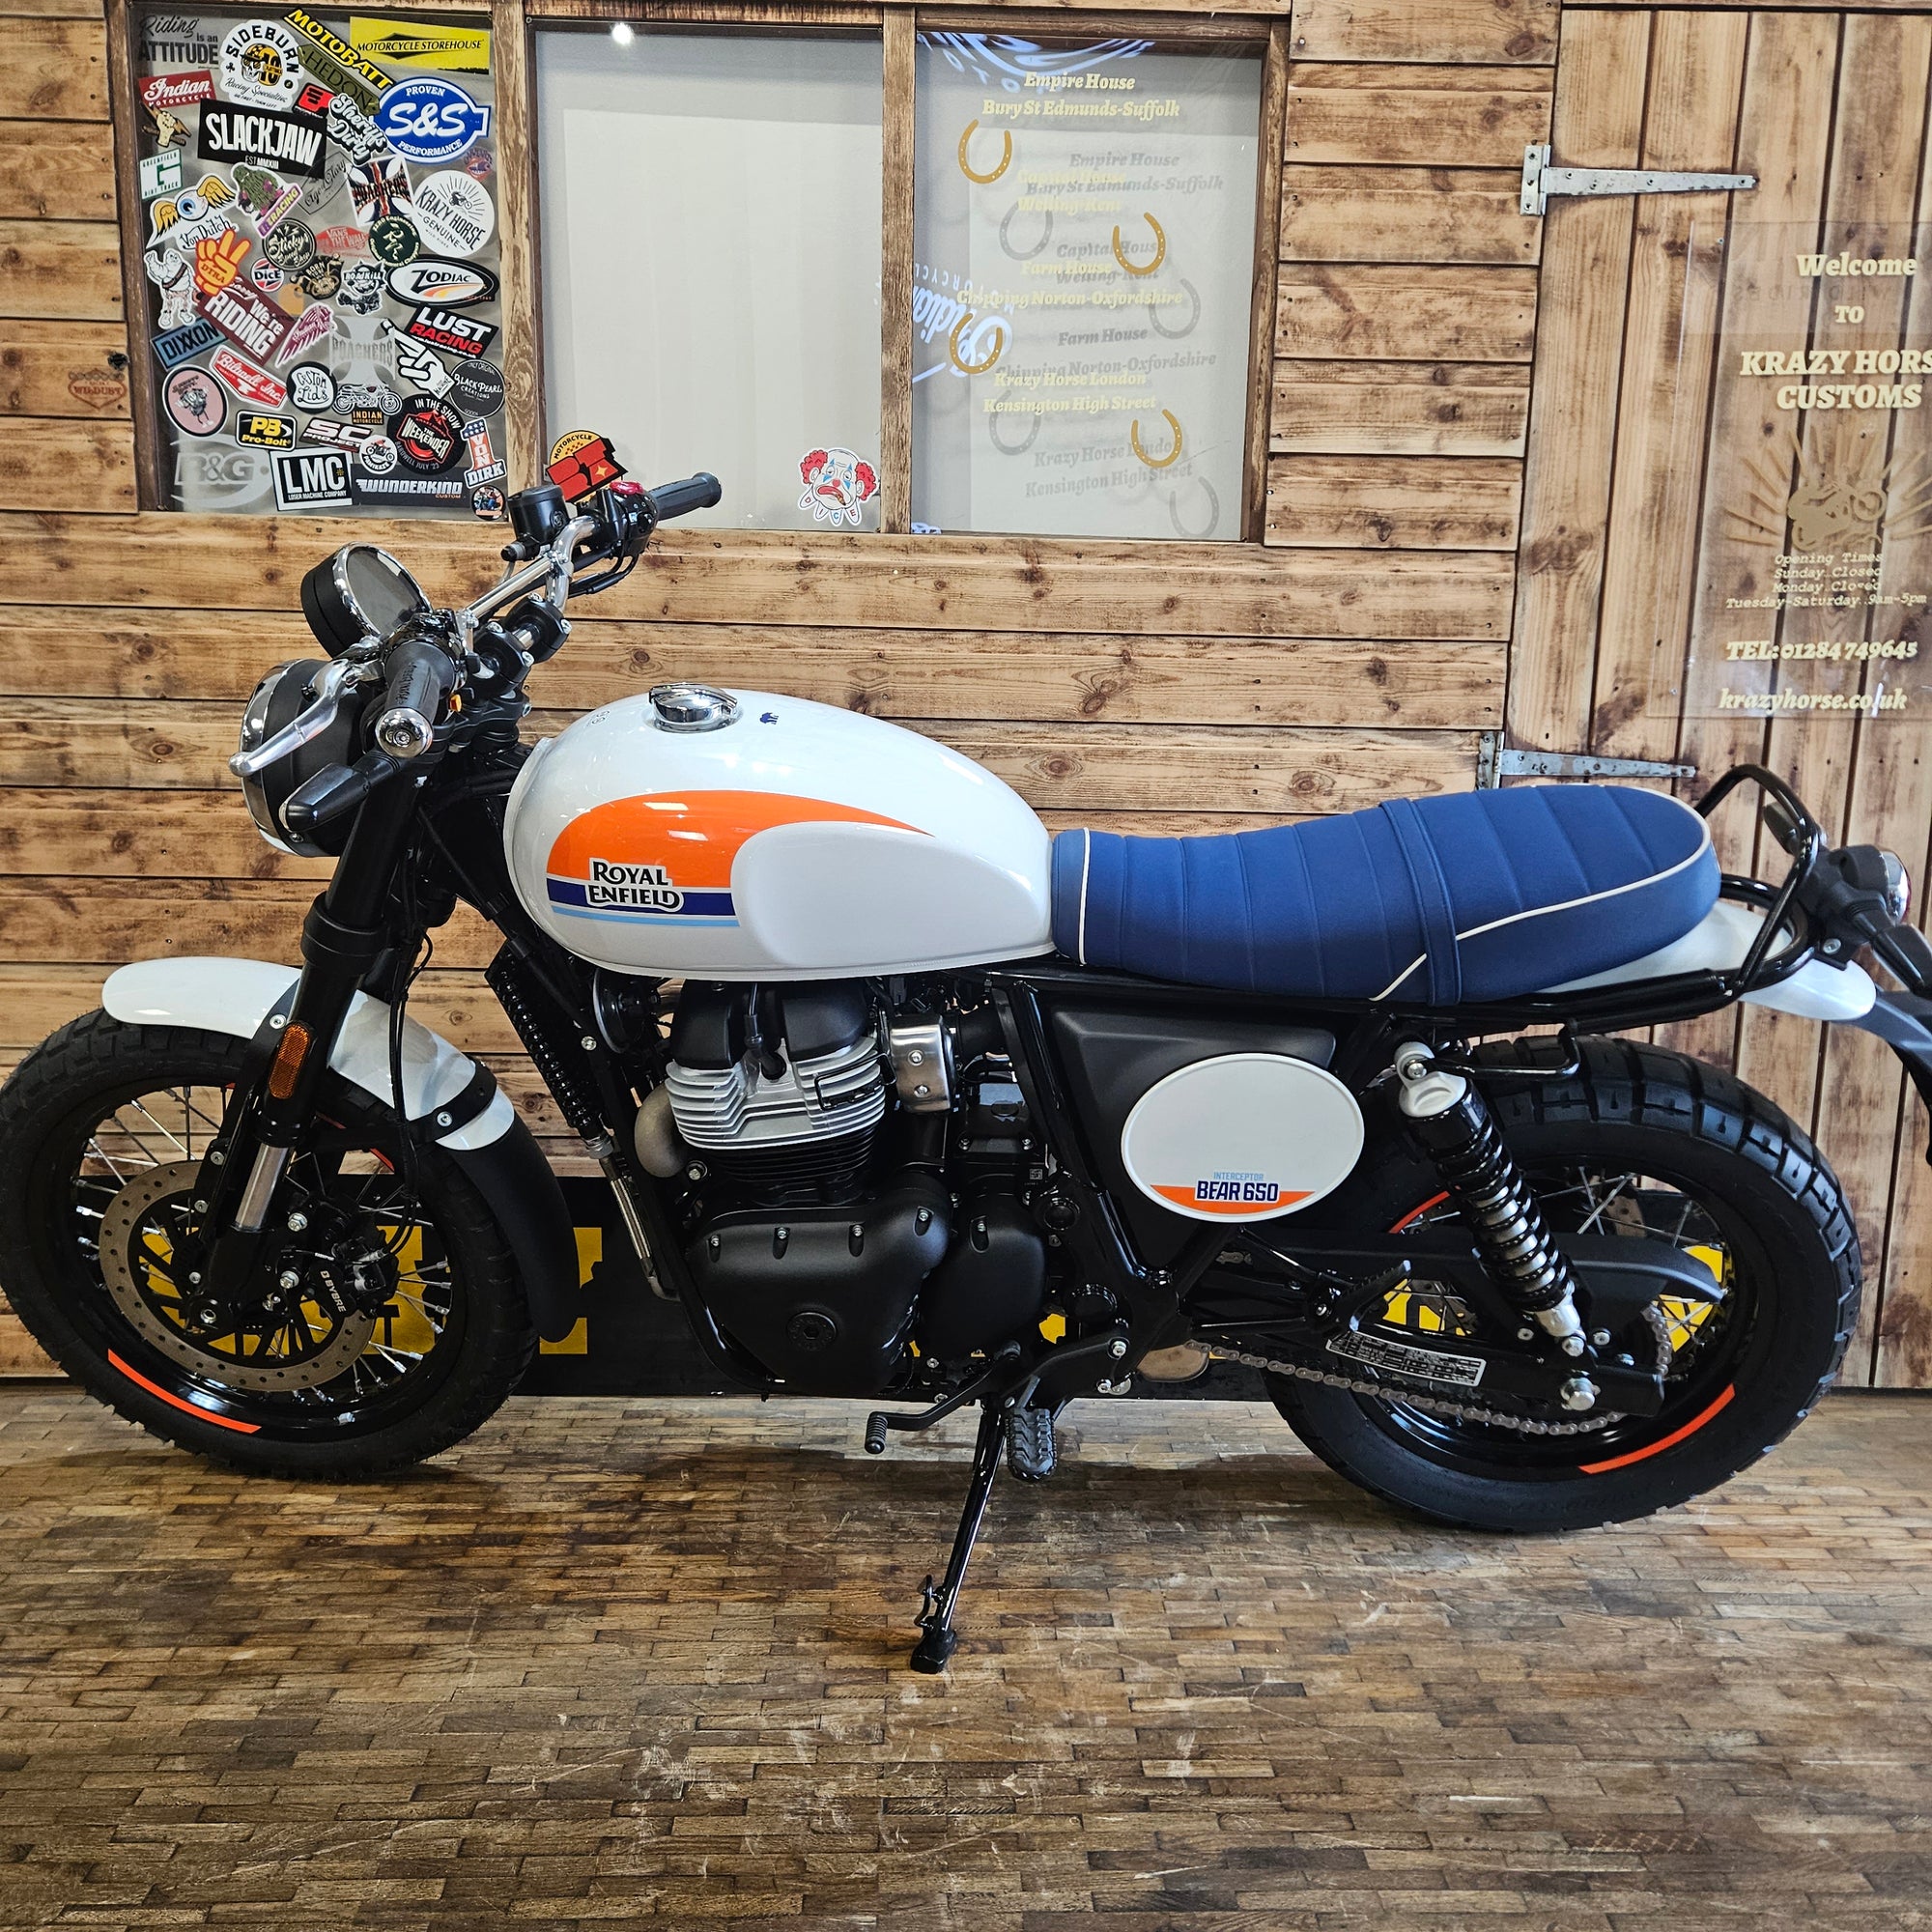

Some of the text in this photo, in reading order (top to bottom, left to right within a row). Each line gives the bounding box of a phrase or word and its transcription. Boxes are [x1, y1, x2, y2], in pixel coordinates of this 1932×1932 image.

[140, 14, 199, 39] Riding
[139, 41, 219, 65] ATTITUDE
[226, 24, 298, 74] SIDEBURN
[289, 10, 393, 89] MOTOBATT
[356, 40, 482, 51] MOTORCYCLE STOREHOUSE
[144, 77, 212, 101] Indian
[225, 77, 249, 93] Racing
[305, 51, 373, 110] HEDON
[406, 85, 445, 97] PROVEN
[1024, 71, 1135, 92] Empire House
[148, 93, 212, 107] MOTORCYCLE
[982, 99, 1180, 120] Bury St Edmunds-Suffolk
[385, 102, 469, 137] S&S
[206, 113, 322, 166] SLACKJAW
[397, 139, 463, 156] PERFORMANCE
[197, 214, 235, 240] Dutch
[415, 185, 453, 222] KRAZY
[449, 213, 486, 251] HORSE
[423, 215, 461, 248] GENUINE
[1796, 252, 1918, 277] Welcome
[411, 270, 471, 294] ZODIAC
[957, 290, 1183, 309] Chipping Norton-Oxfordshire
[204, 290, 276, 356] RIDING
[250, 298, 285, 336] We're
[415, 307, 492, 341] LUST
[1835, 305, 1864, 324] TO
[160, 323, 219, 360] DIXXON
[410, 323, 483, 355] RACING
[1740, 351, 1850, 376] KRAZY
[994, 372, 1147, 390] Krazy Horse London
[983, 397, 1156, 416] Kensington High Street
[1776, 384, 1922, 410] CUSTOMS
[414, 398, 425, 409] IN
[426, 398, 441, 412] THE
[440, 405, 461, 429] SHOW
[250, 416, 282, 437] PB
[306, 418, 372, 441] SC
[402, 417, 450, 459] WEEKENDER
[554, 434, 593, 460] MOTORCYCLE
[176, 452, 255, 483] R&G
[283, 456, 345, 494] LMC
[466, 462, 505, 486] DIRK
[357, 478, 463, 494] WUNDERKIND
[1775, 552, 1884, 566] Opening Times
[1845, 640, 1918, 660] 749645
[1719, 688, 1908, 715] krazyhorse.couk
[593, 861, 668, 886] ROYAL
[588, 885, 680, 909] ENFIELD
[1214, 1171, 1264, 1181] INTERCEPTOR
[1197, 1180, 1279, 1202] BEAR 650
[325, 1279, 347, 1314] BYBRE
